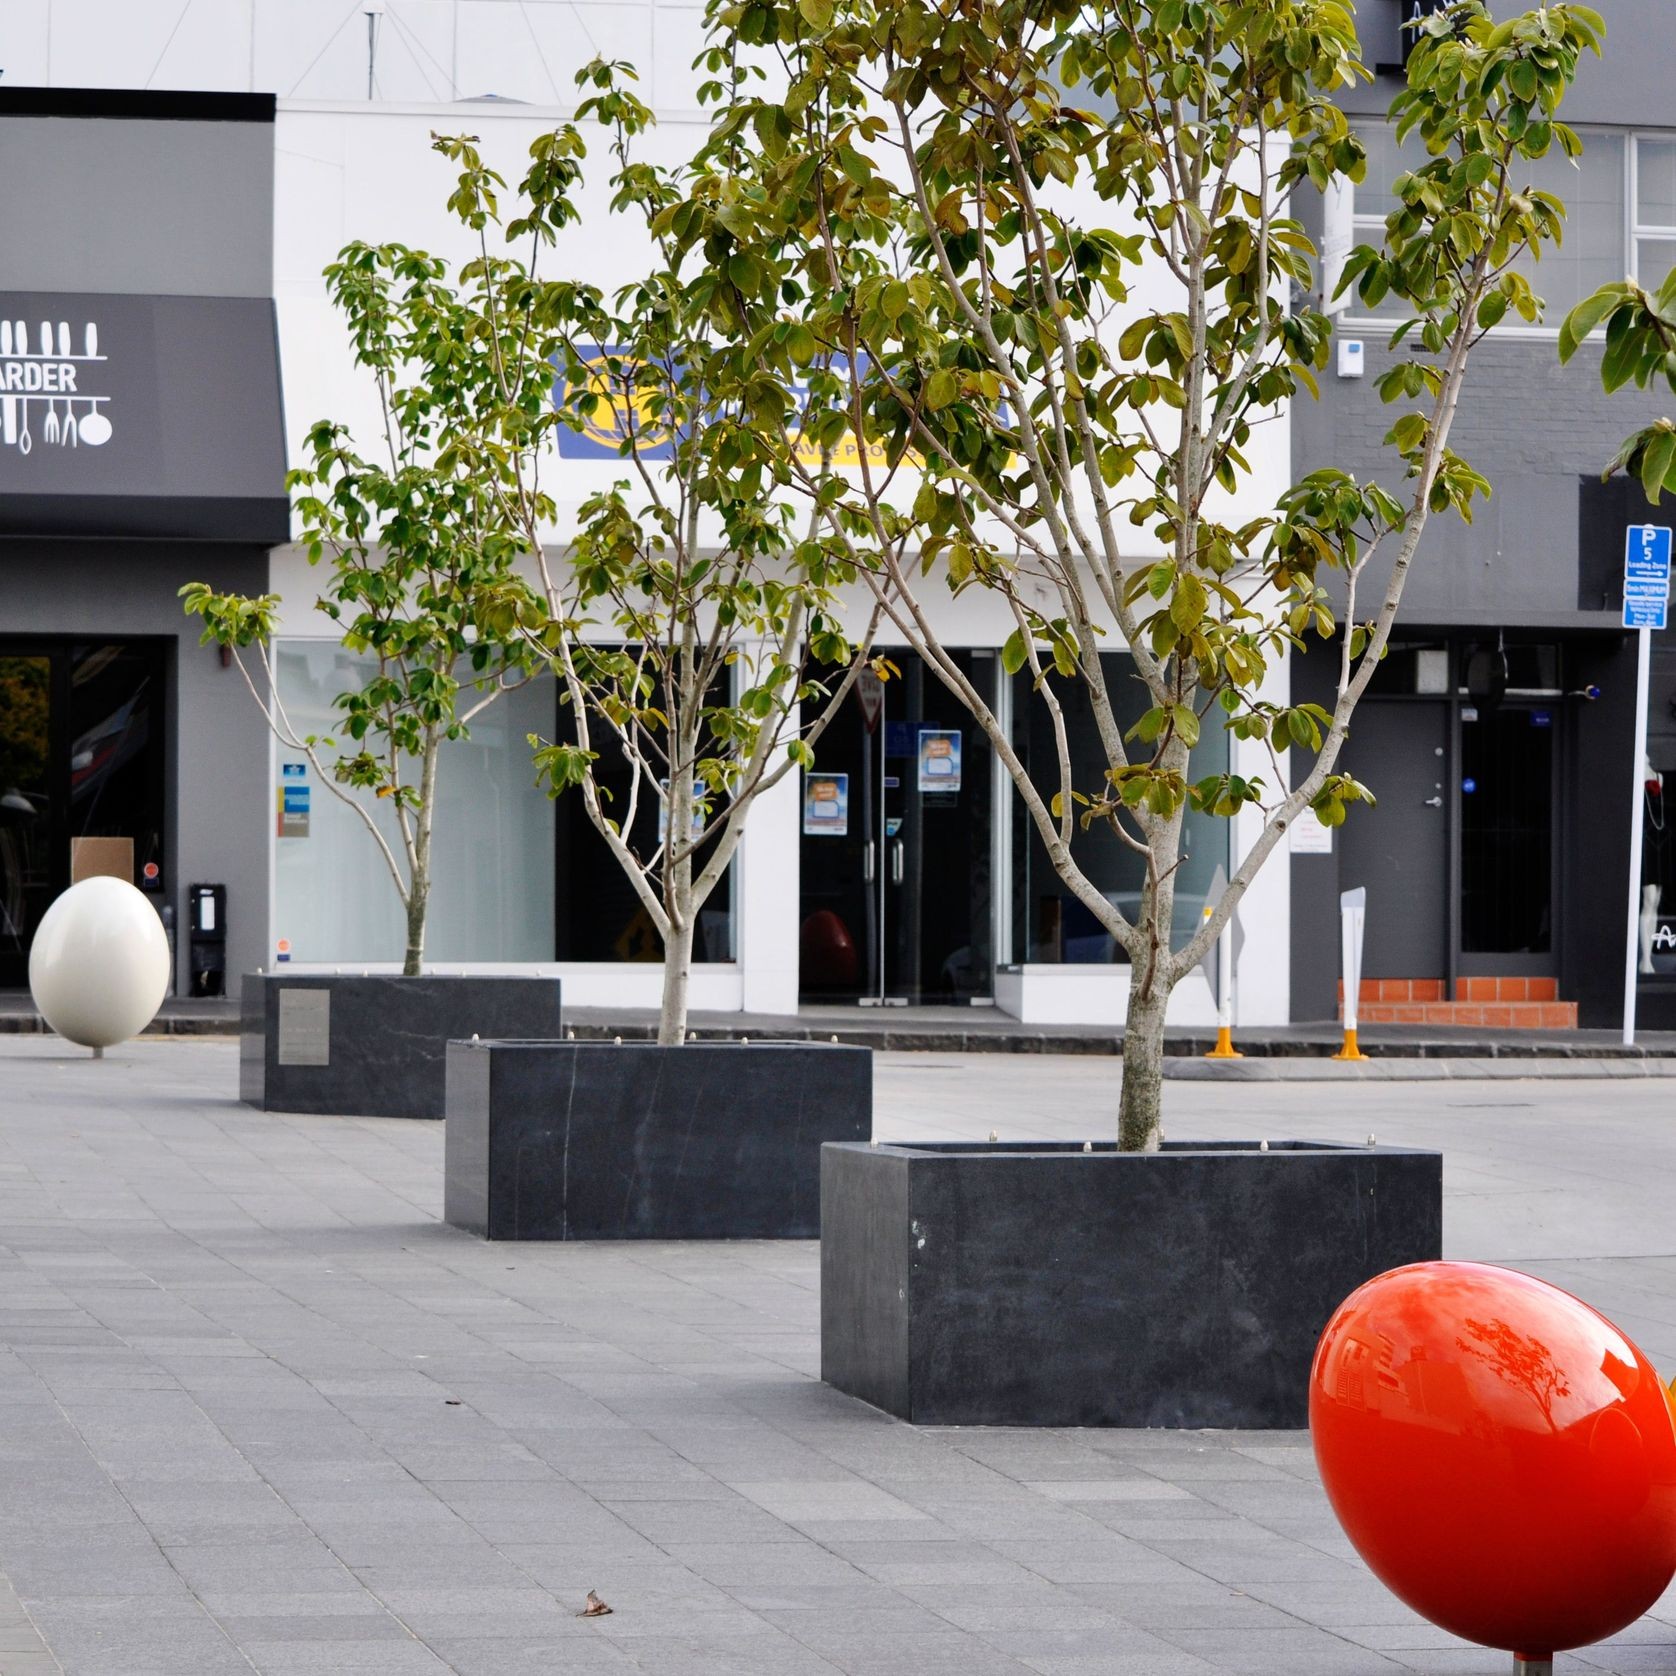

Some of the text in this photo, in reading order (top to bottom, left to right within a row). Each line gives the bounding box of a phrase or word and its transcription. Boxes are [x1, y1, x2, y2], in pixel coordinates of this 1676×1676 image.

[1642, 529, 1656, 546] P
[1643, 547, 1652, 561] 5
[1628, 561, 1667, 570] Loading Zone
